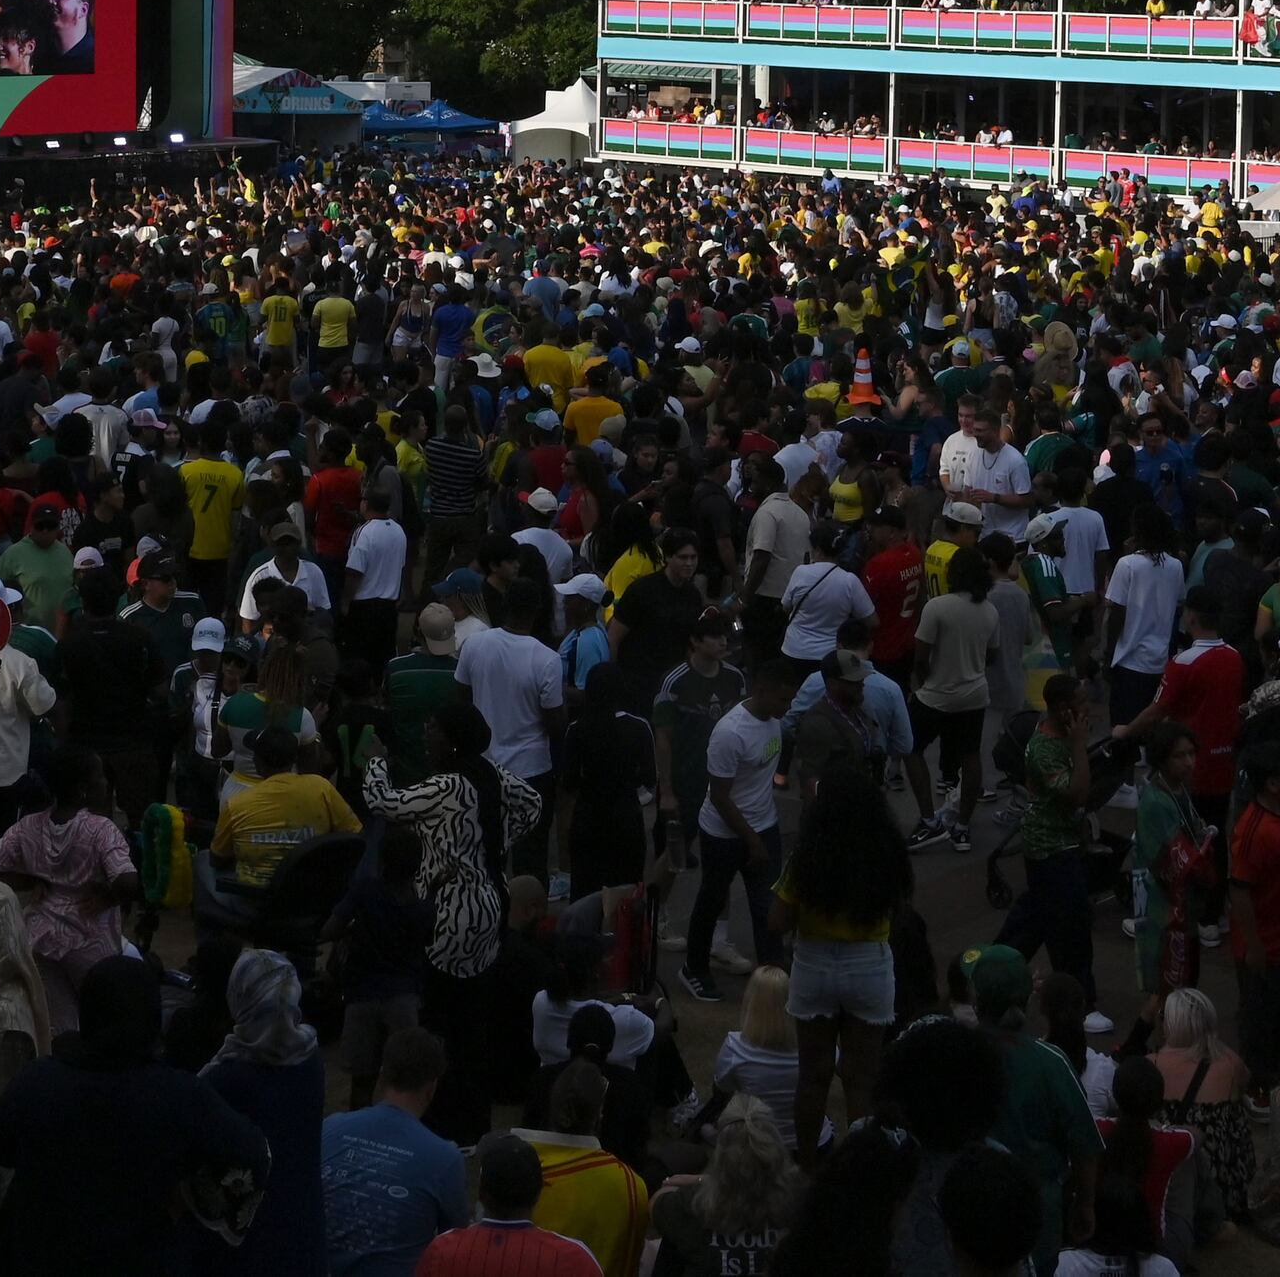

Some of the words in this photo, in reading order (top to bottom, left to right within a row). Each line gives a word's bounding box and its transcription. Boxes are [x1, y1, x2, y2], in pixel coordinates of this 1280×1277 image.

[281, 96, 331, 112] DRINKS
[200, 484, 219, 513] 7
[899, 579, 920, 618] 2
